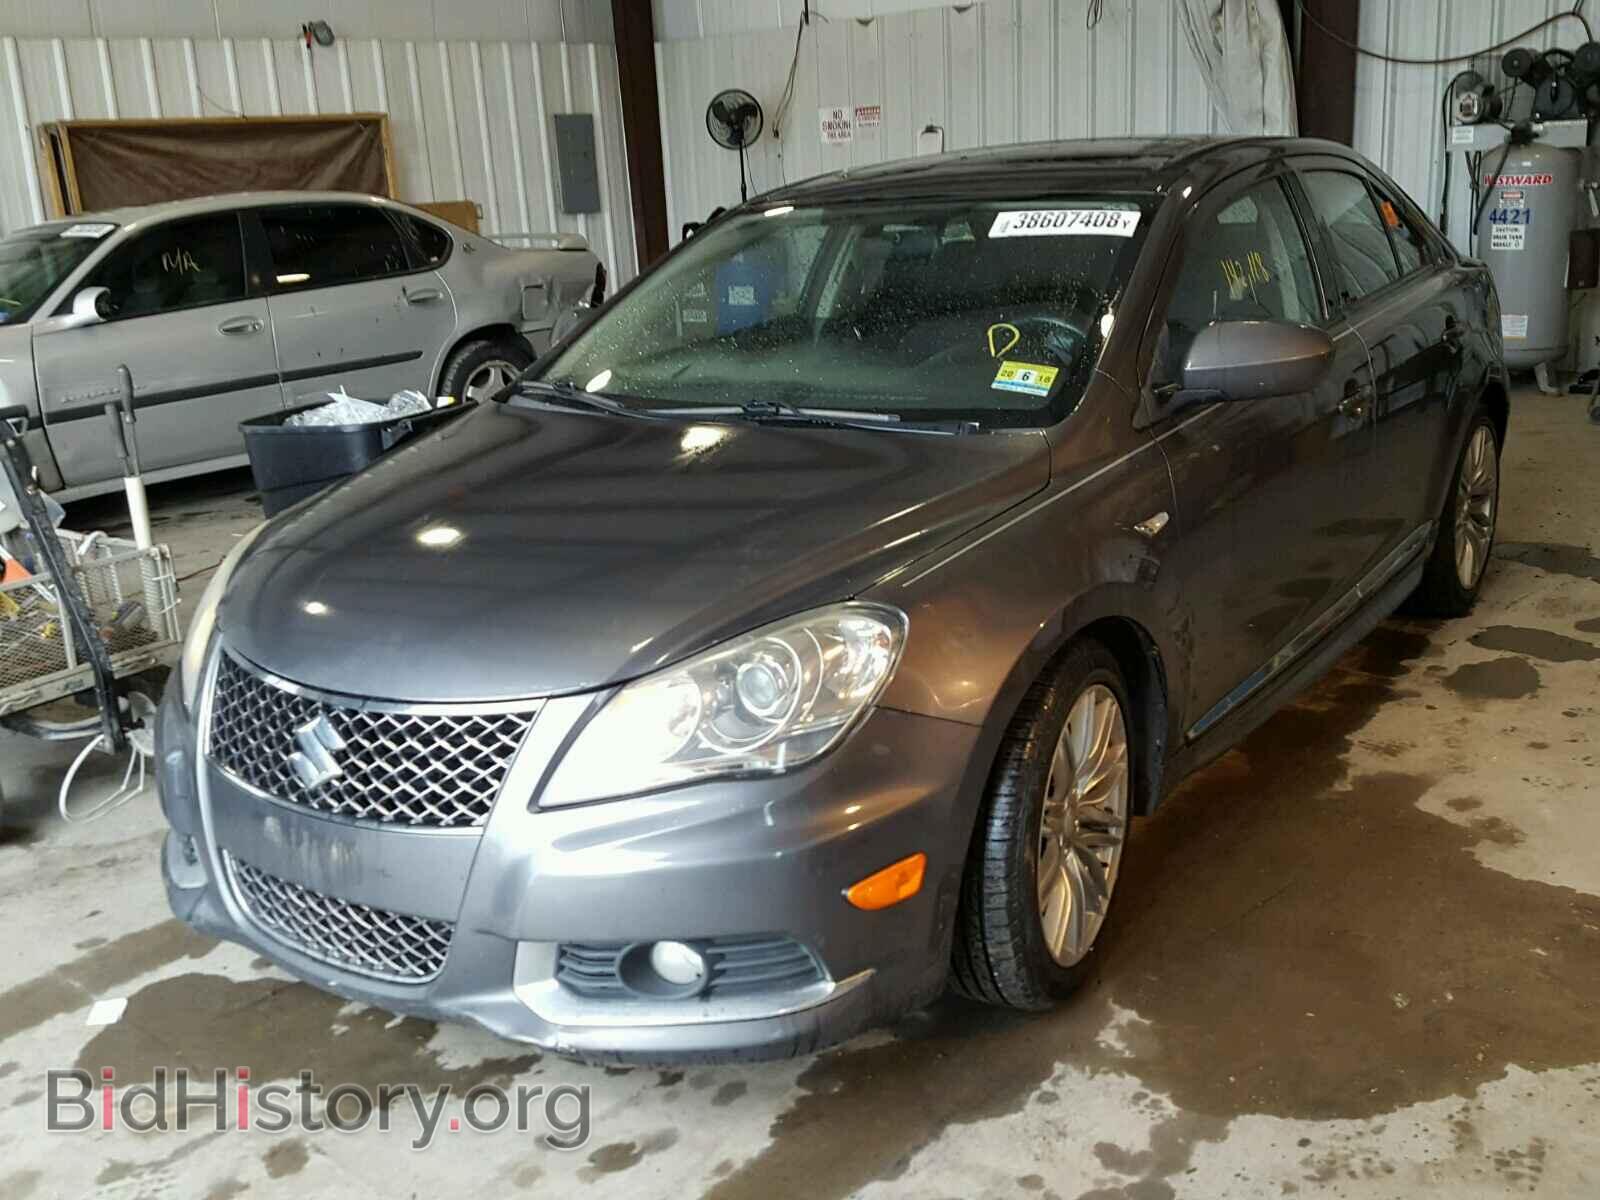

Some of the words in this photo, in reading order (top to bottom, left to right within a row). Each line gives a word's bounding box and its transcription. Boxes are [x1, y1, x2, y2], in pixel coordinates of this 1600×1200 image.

[832, 109, 843, 120] NO
[1484, 174, 1553, 186] WSTWARD
[1013, 211, 1122, 230] 38607408
[1489, 208, 1531, 225] 4421
[1022, 371, 1031, 382] 6
